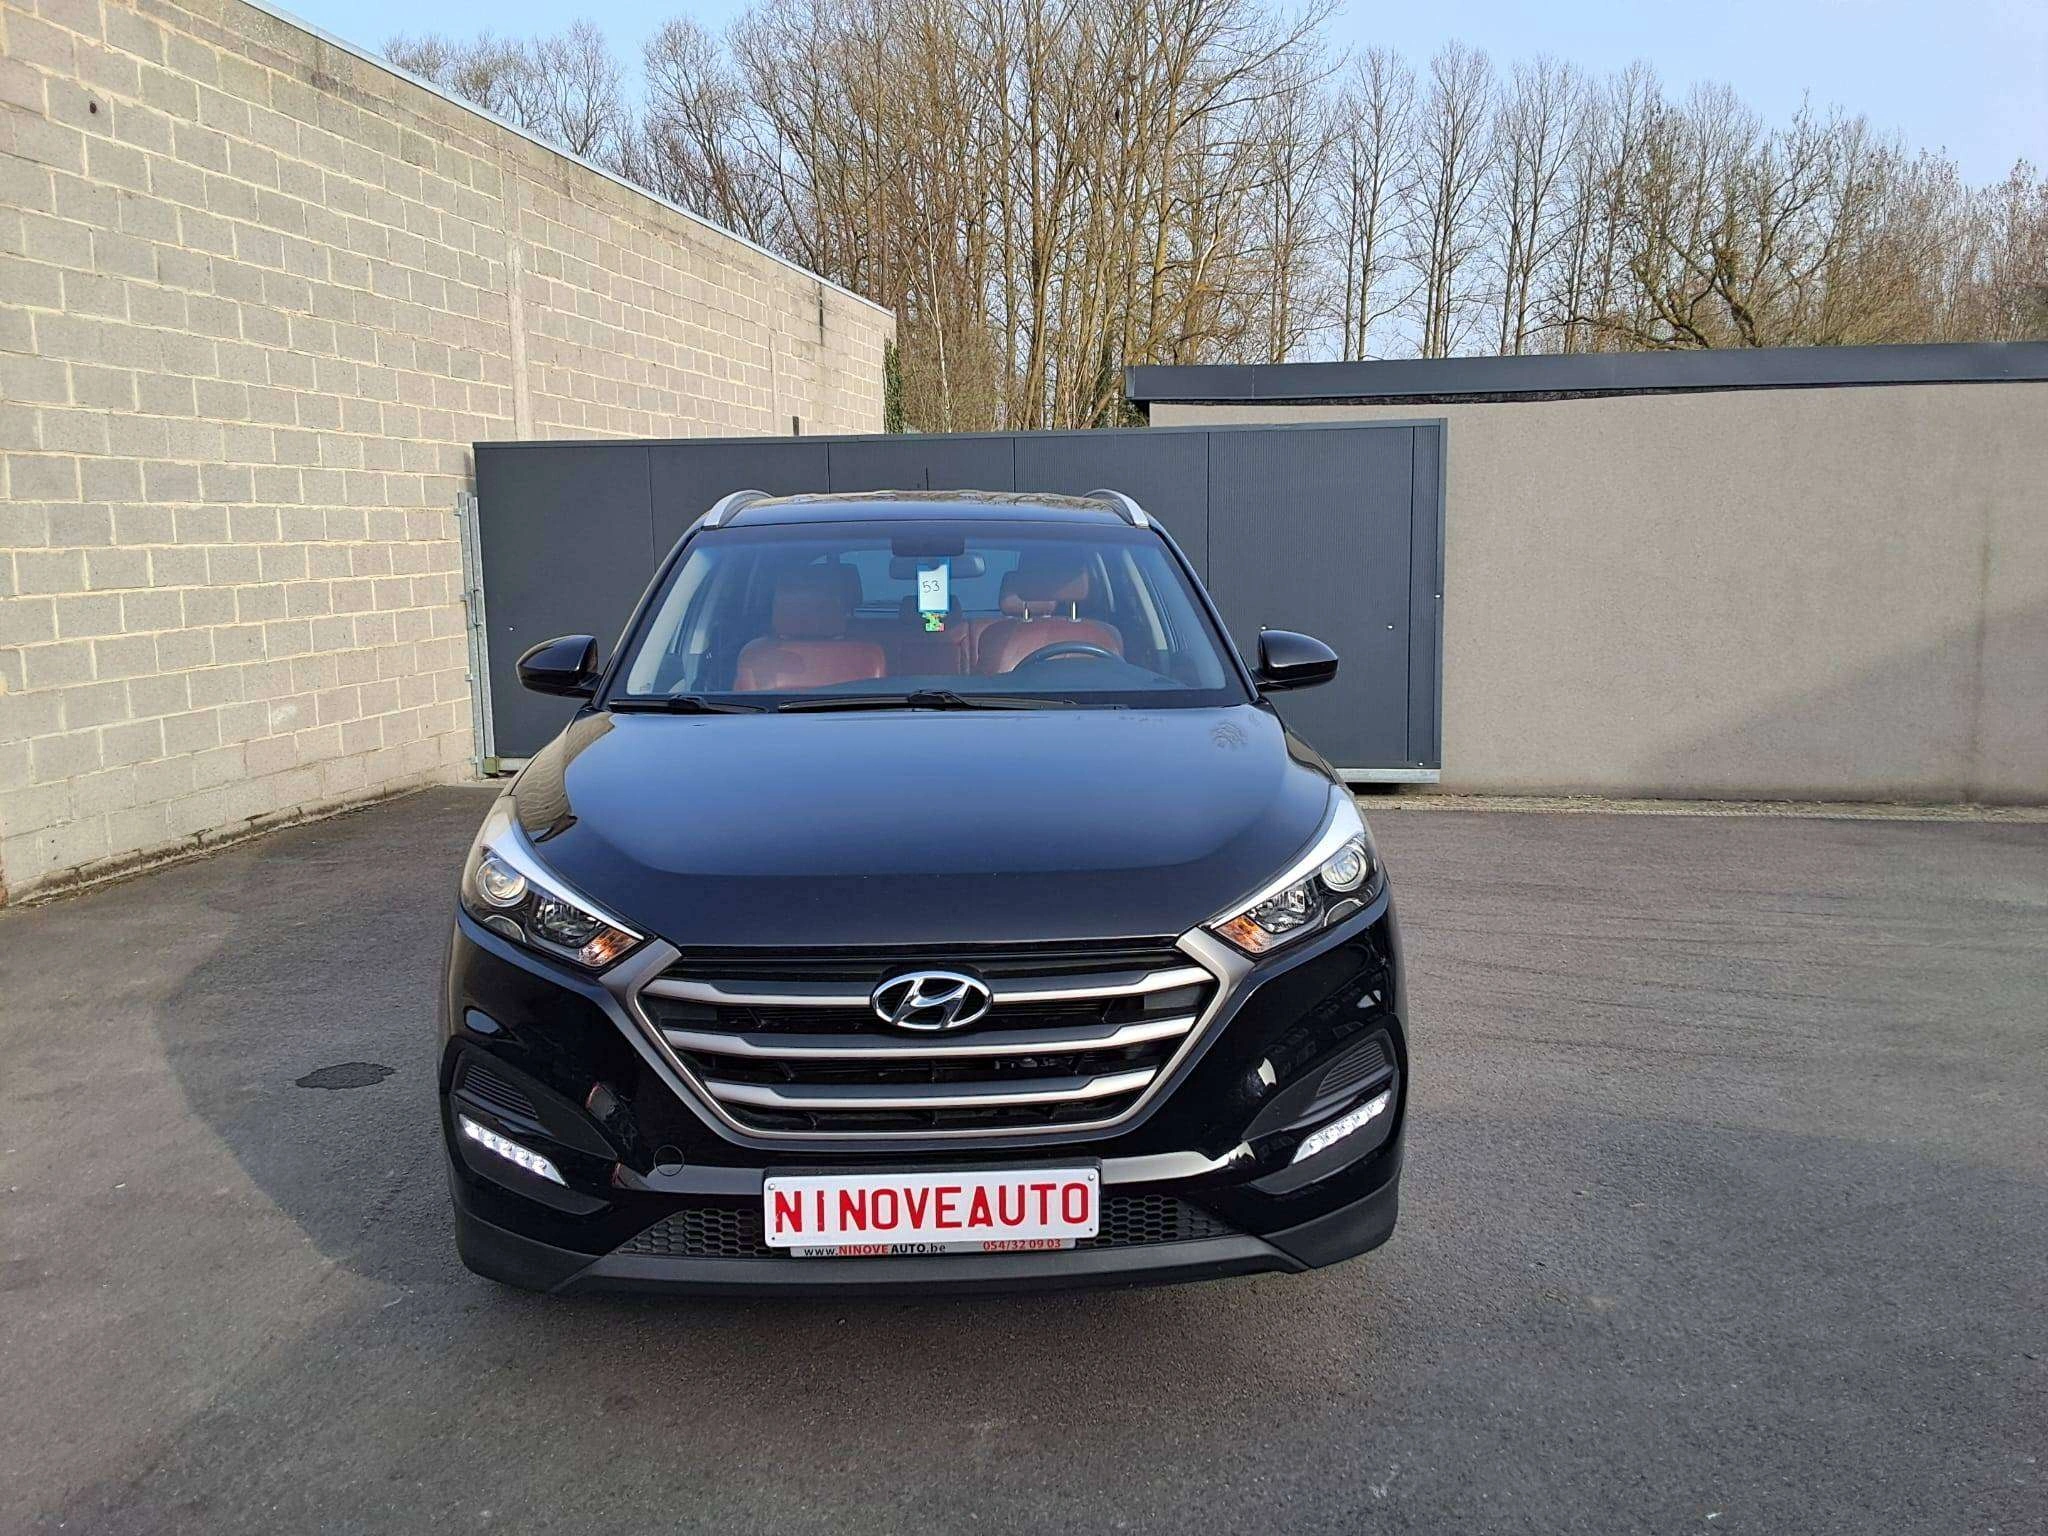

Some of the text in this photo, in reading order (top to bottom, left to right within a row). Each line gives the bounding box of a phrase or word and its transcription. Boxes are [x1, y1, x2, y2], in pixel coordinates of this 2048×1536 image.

[922, 579, 941, 594] 53
[774, 1183, 1090, 1234] NINOVEAUTO
[982, 1238, 1061, 1251] 054/32 09 03
